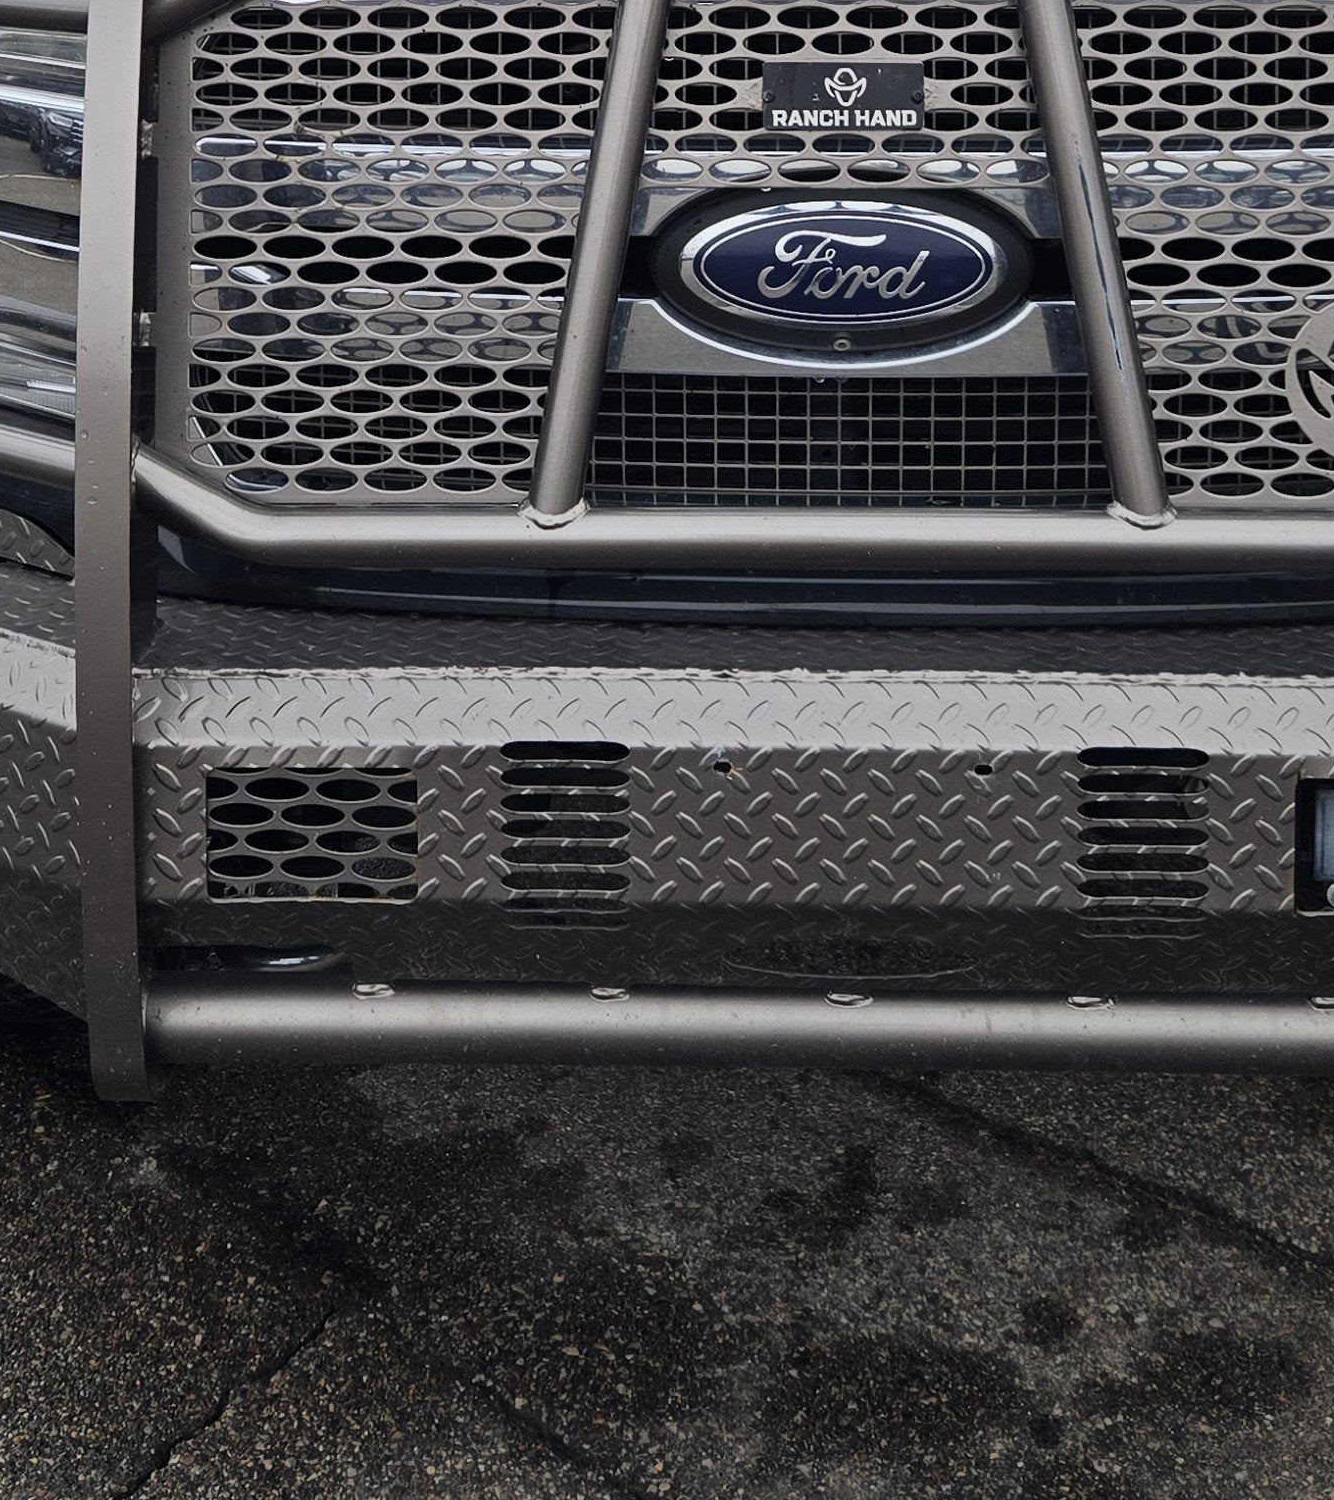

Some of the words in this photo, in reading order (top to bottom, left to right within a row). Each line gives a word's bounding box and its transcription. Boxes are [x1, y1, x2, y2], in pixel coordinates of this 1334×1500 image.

[772, 109, 850, 127] RANCH
[855, 109, 917, 127] HAND
[757, 230, 930, 299] Ford
